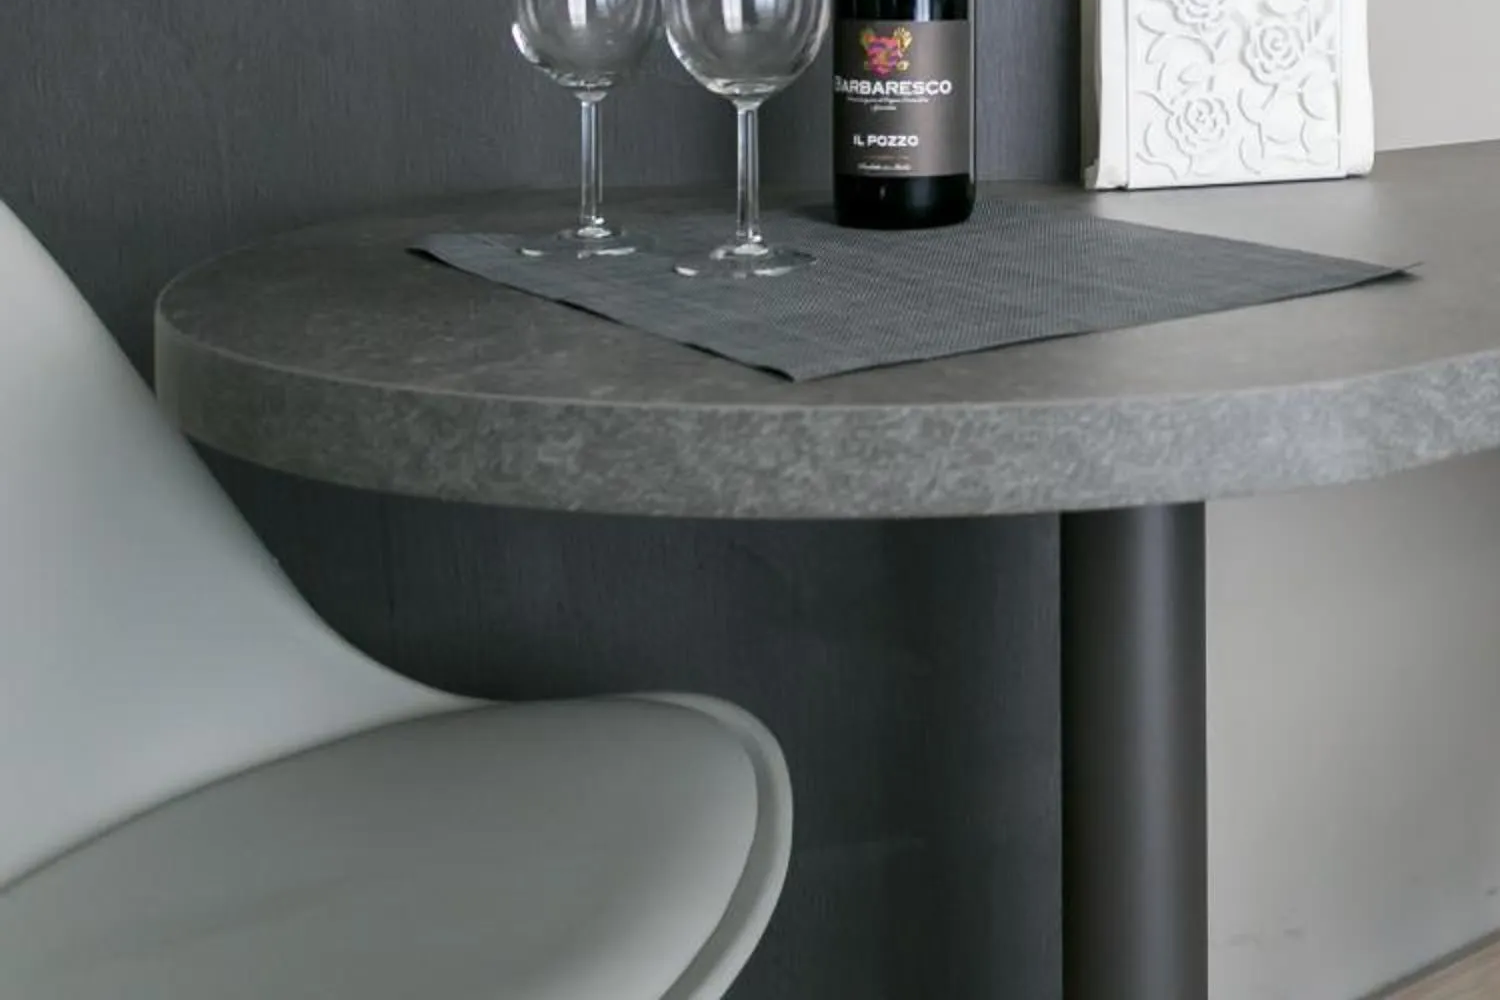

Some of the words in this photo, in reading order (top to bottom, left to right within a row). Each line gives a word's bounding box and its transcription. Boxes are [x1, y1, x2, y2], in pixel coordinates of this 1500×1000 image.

[835, 77, 952, 95] BARBARESCO
[853, 135, 864, 147] IL
[867, 135, 919, 147] POZZO
